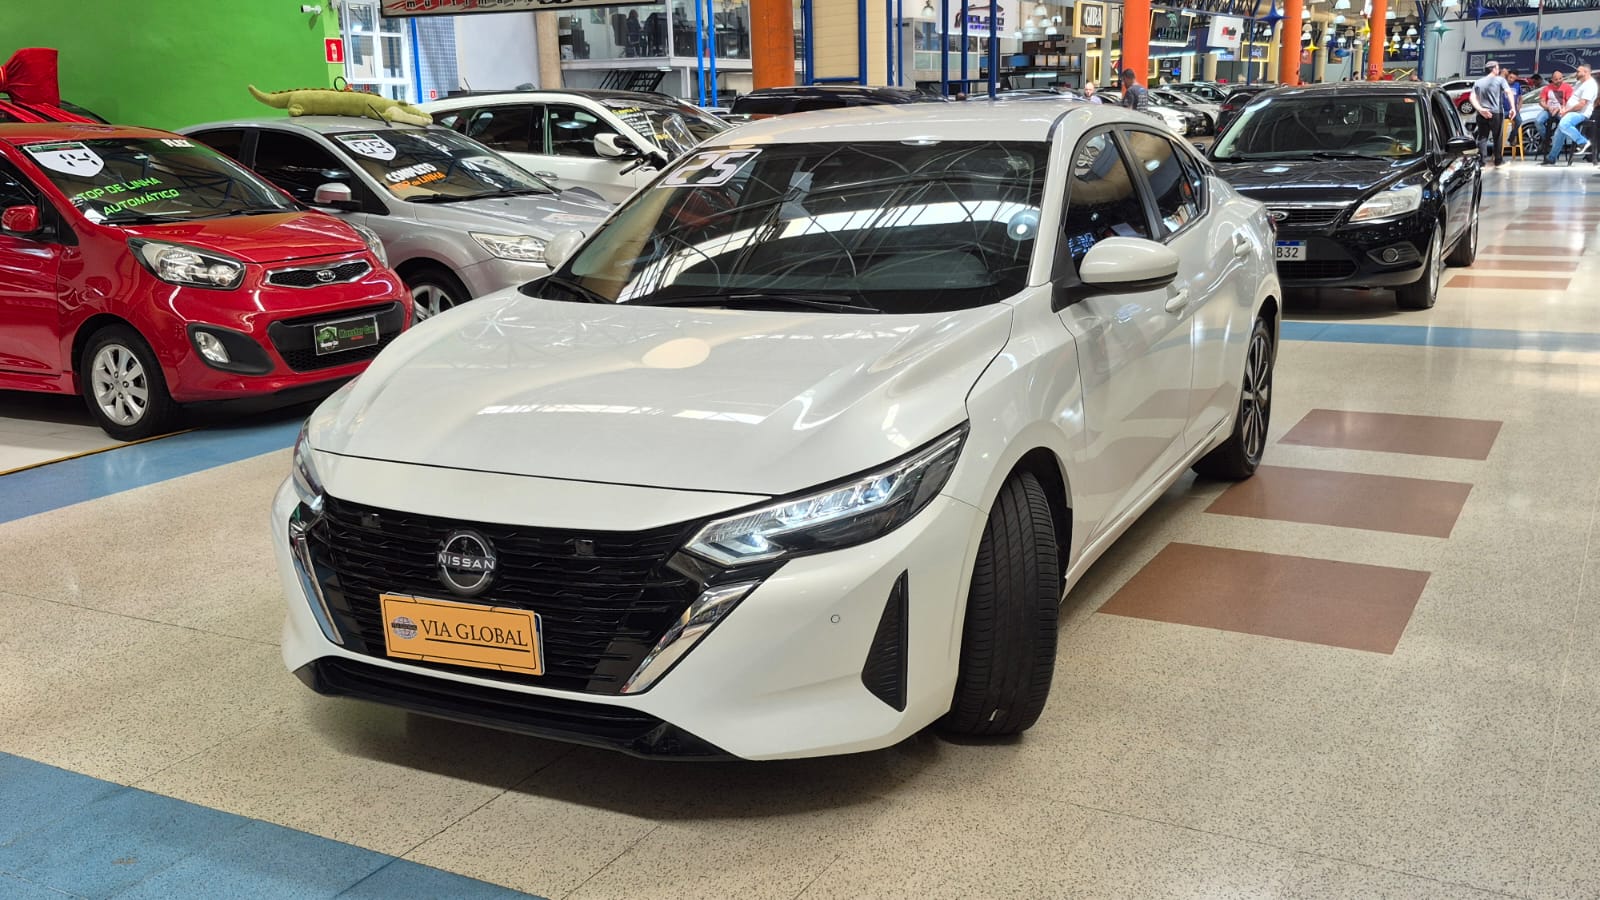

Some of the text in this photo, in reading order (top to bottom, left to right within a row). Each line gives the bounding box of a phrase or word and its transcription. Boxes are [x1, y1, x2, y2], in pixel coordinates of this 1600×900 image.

[1085, 6, 1103, 26] GIBA
[385, 162, 438, 183] COMPLETO
[420, 171, 447, 186] LINHA
[664, 152, 751, 185] 25
[77, 177, 163, 204] TOP DE LINHA
[103, 188, 181, 216] AUTOMÁTICO
[1276, 246, 1299, 258] B32
[438, 553, 496, 570] NISSAN
[420, 619, 452, 638] VIA
[455, 623, 528, 647] GLOBAL
